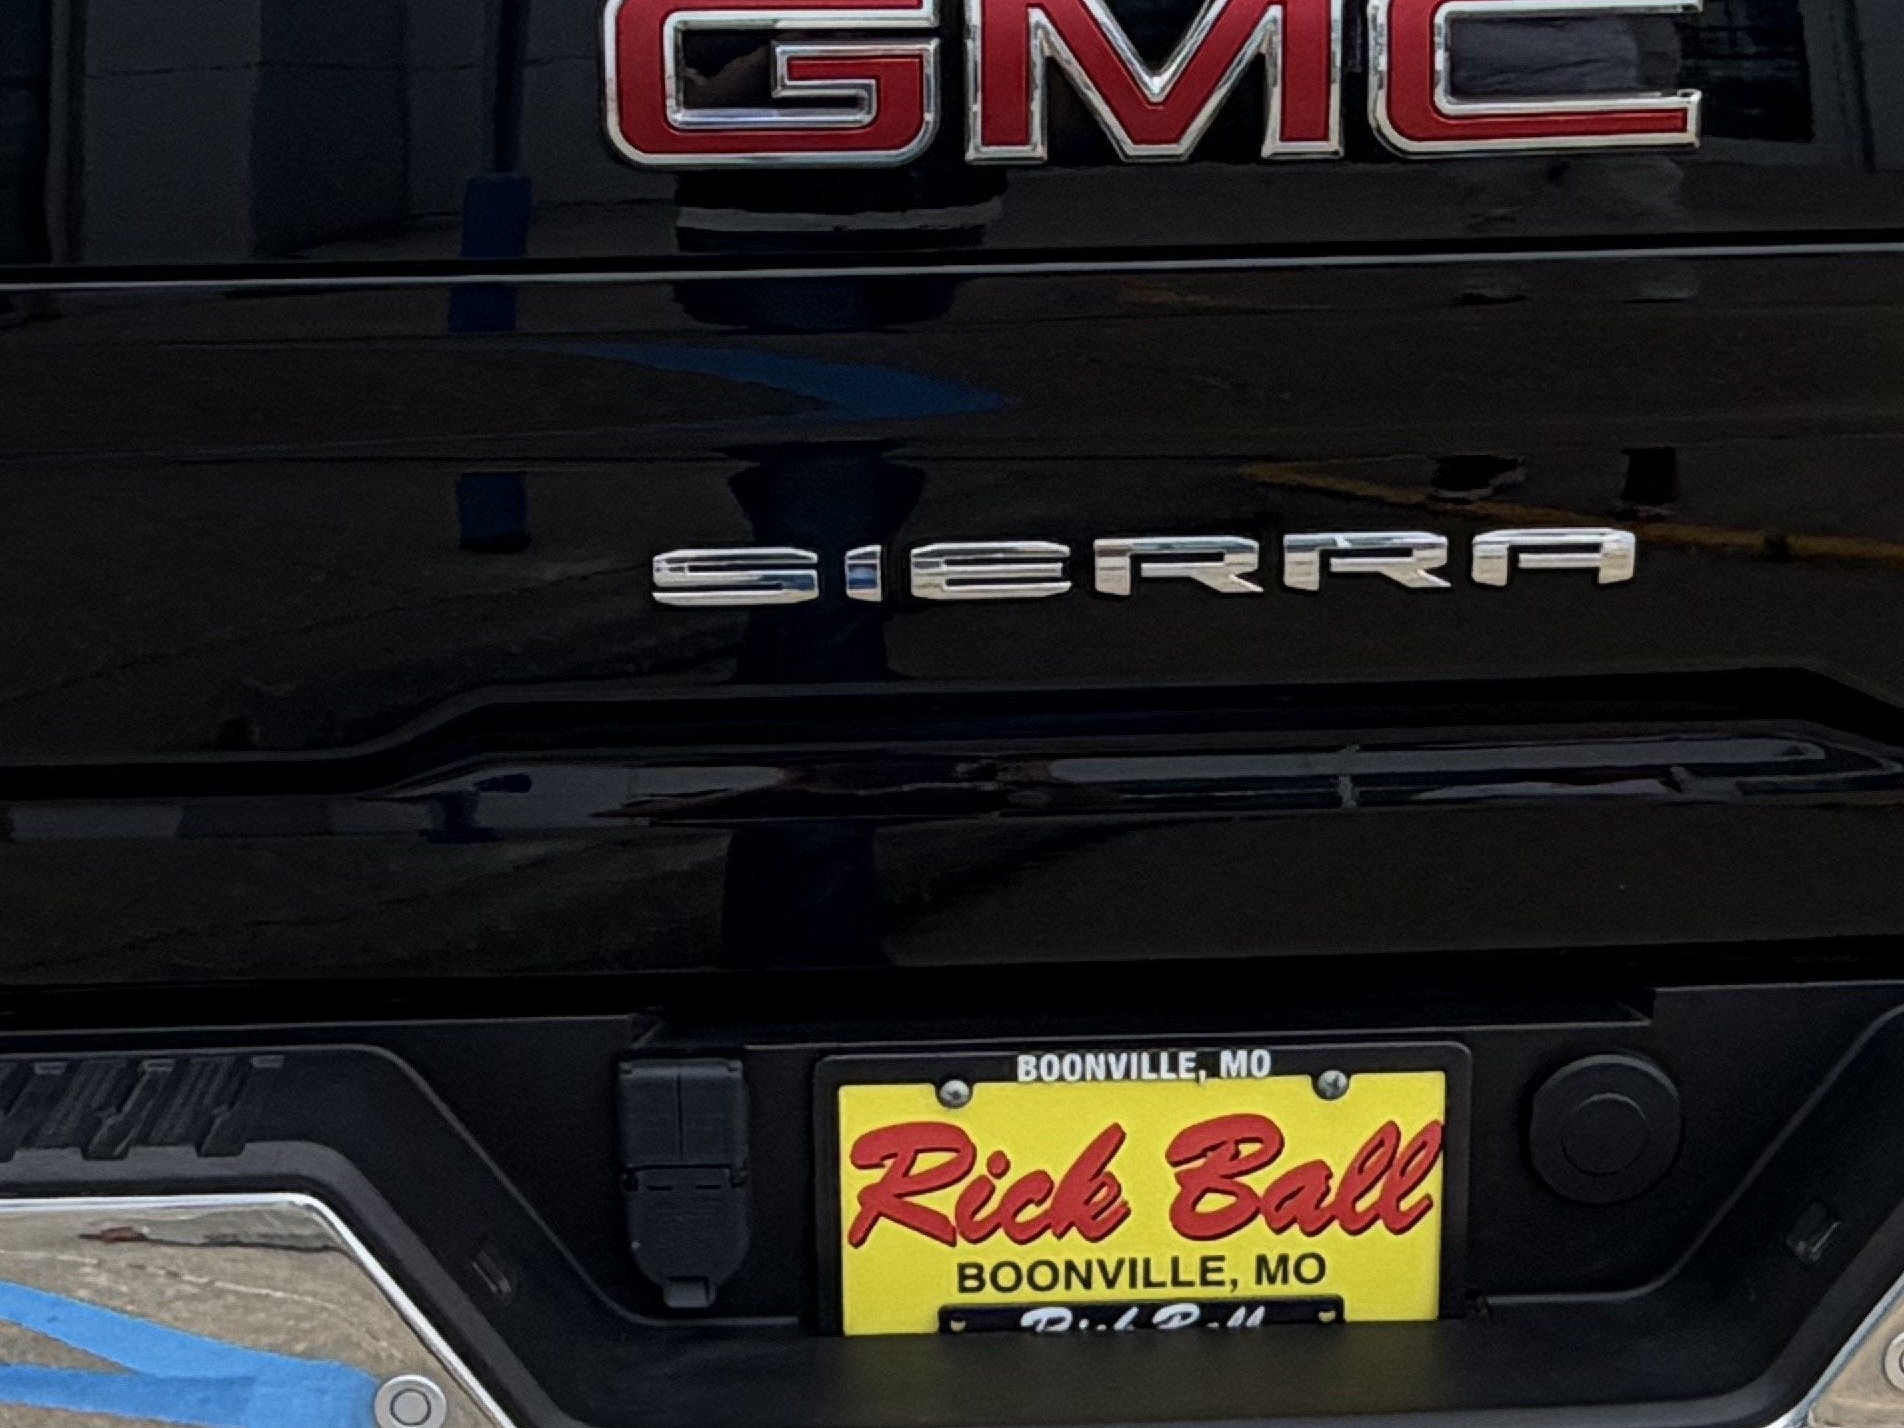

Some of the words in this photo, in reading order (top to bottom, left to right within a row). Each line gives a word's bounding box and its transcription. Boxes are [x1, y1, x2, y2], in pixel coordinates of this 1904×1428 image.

[651, 525, 1637, 607] SIERRA
[1015, 1050, 1209, 1086] BOONVILLE,
[1218, 1047, 1272, 1079] MO
[846, 1120, 1132, 1248] Rick
[1164, 1112, 1445, 1242] Ball
[955, 1254, 1238, 1294] BOONVILLE,
[1252, 1252, 1327, 1286] MO
